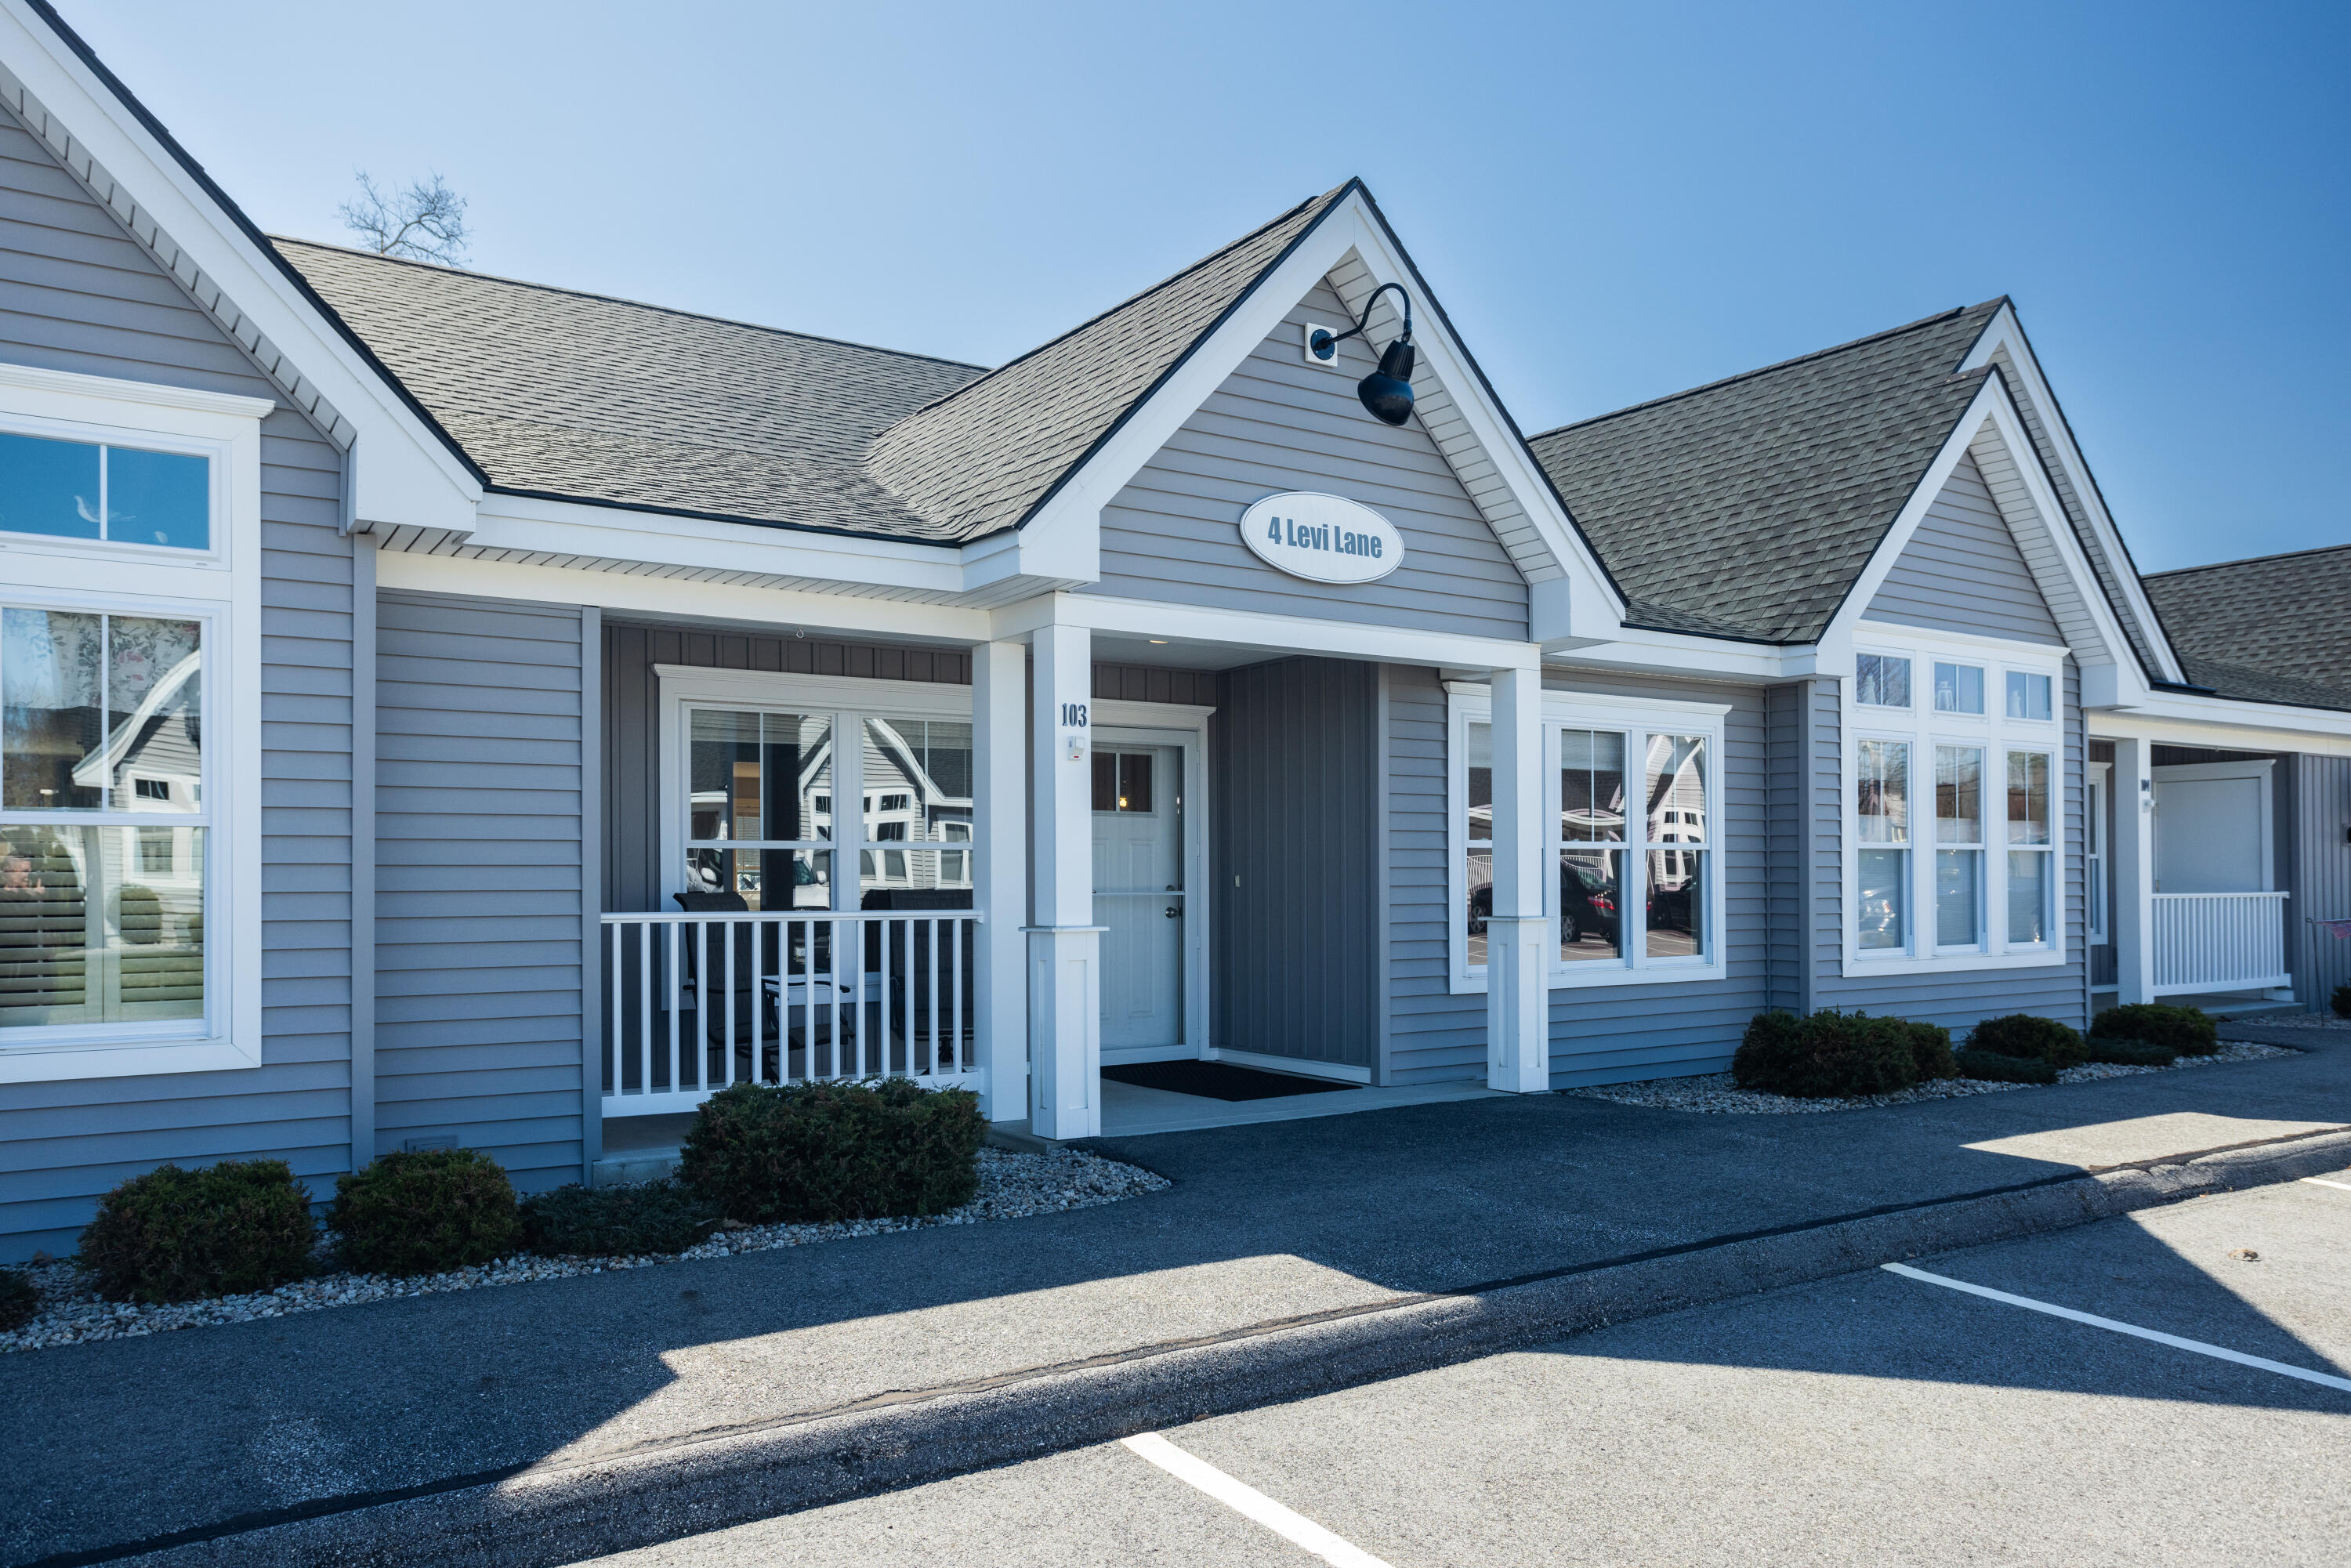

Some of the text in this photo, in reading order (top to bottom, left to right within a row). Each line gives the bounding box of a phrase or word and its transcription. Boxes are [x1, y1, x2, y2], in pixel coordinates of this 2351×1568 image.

[1267, 516, 1382, 559] 4 Levi Lane
[1062, 702, 1088, 728] 103
